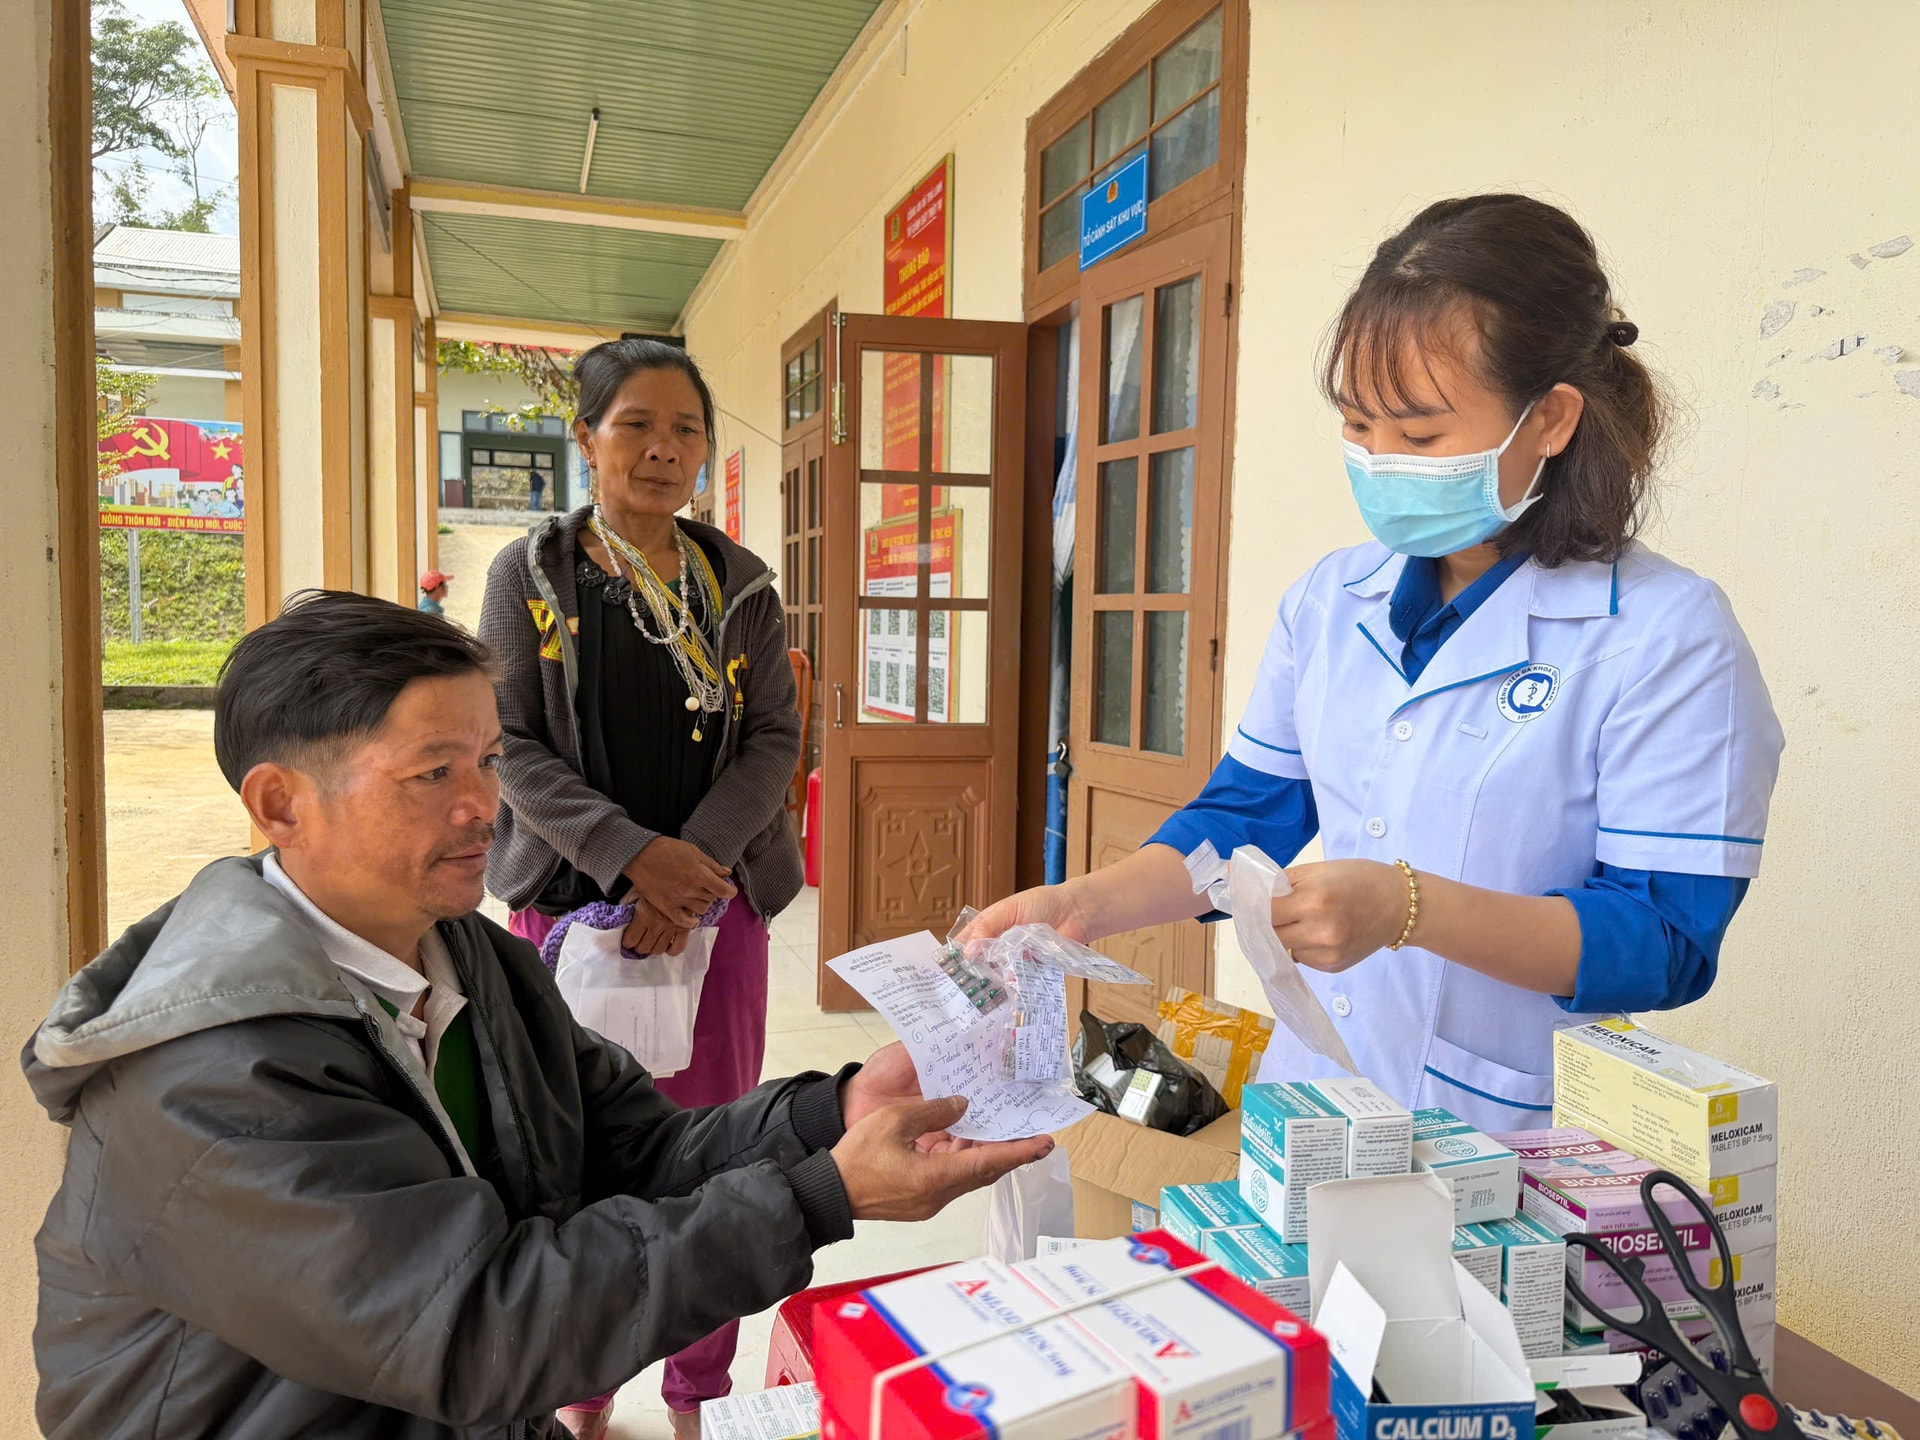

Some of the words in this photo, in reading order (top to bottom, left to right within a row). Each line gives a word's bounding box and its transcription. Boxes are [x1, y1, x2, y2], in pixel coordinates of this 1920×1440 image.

[1091, 224, 1106, 244] CẢNH
[1106, 215, 1117, 234] SÁT
[1118, 208, 1130, 226] KHU
[1130, 199, 1143, 218] VỰC
[102, 514, 122, 524] NÔNG
[125, 514, 145, 525] THÔN
[224, 519, 242, 530] CUỘC
[1577, 1028, 1616, 1048] TABLETS
[1616, 1041, 1630, 1052] BP
[1631, 1049, 1659, 1064] 7.5mg
[1586, 1024, 1662, 1056] MELOXICAM
[1711, 1122, 1763, 1144] MELOXICAM
[1712, 1140, 1740, 1153] TABLETS
[1742, 1137, 1752, 1146] BP
[1753, 1133, 1773, 1143] 7.5mg
[1515, 1143, 1603, 1158] BIOSEPTI
[1562, 1173, 1649, 1187] BIOSEPTI
[1538, 1182, 1570, 1209] BIOSEPTIL
[1712, 1203, 1763, 1224] MELOXICAM
[1720, 1221, 1741, 1231] BLETS
[1743, 1217, 1752, 1227] BP
[1753, 1213, 1772, 1224] 7.5mg
[1600, 1229, 1700, 1254] BIOSEIL
[1734, 1282, 1764, 1298] XICAM
[1744, 1296, 1754, 1305] BP
[1754, 1292, 1772, 1302] 7.5mg
[1375, 1416, 1483, 1440] CALCIUM
